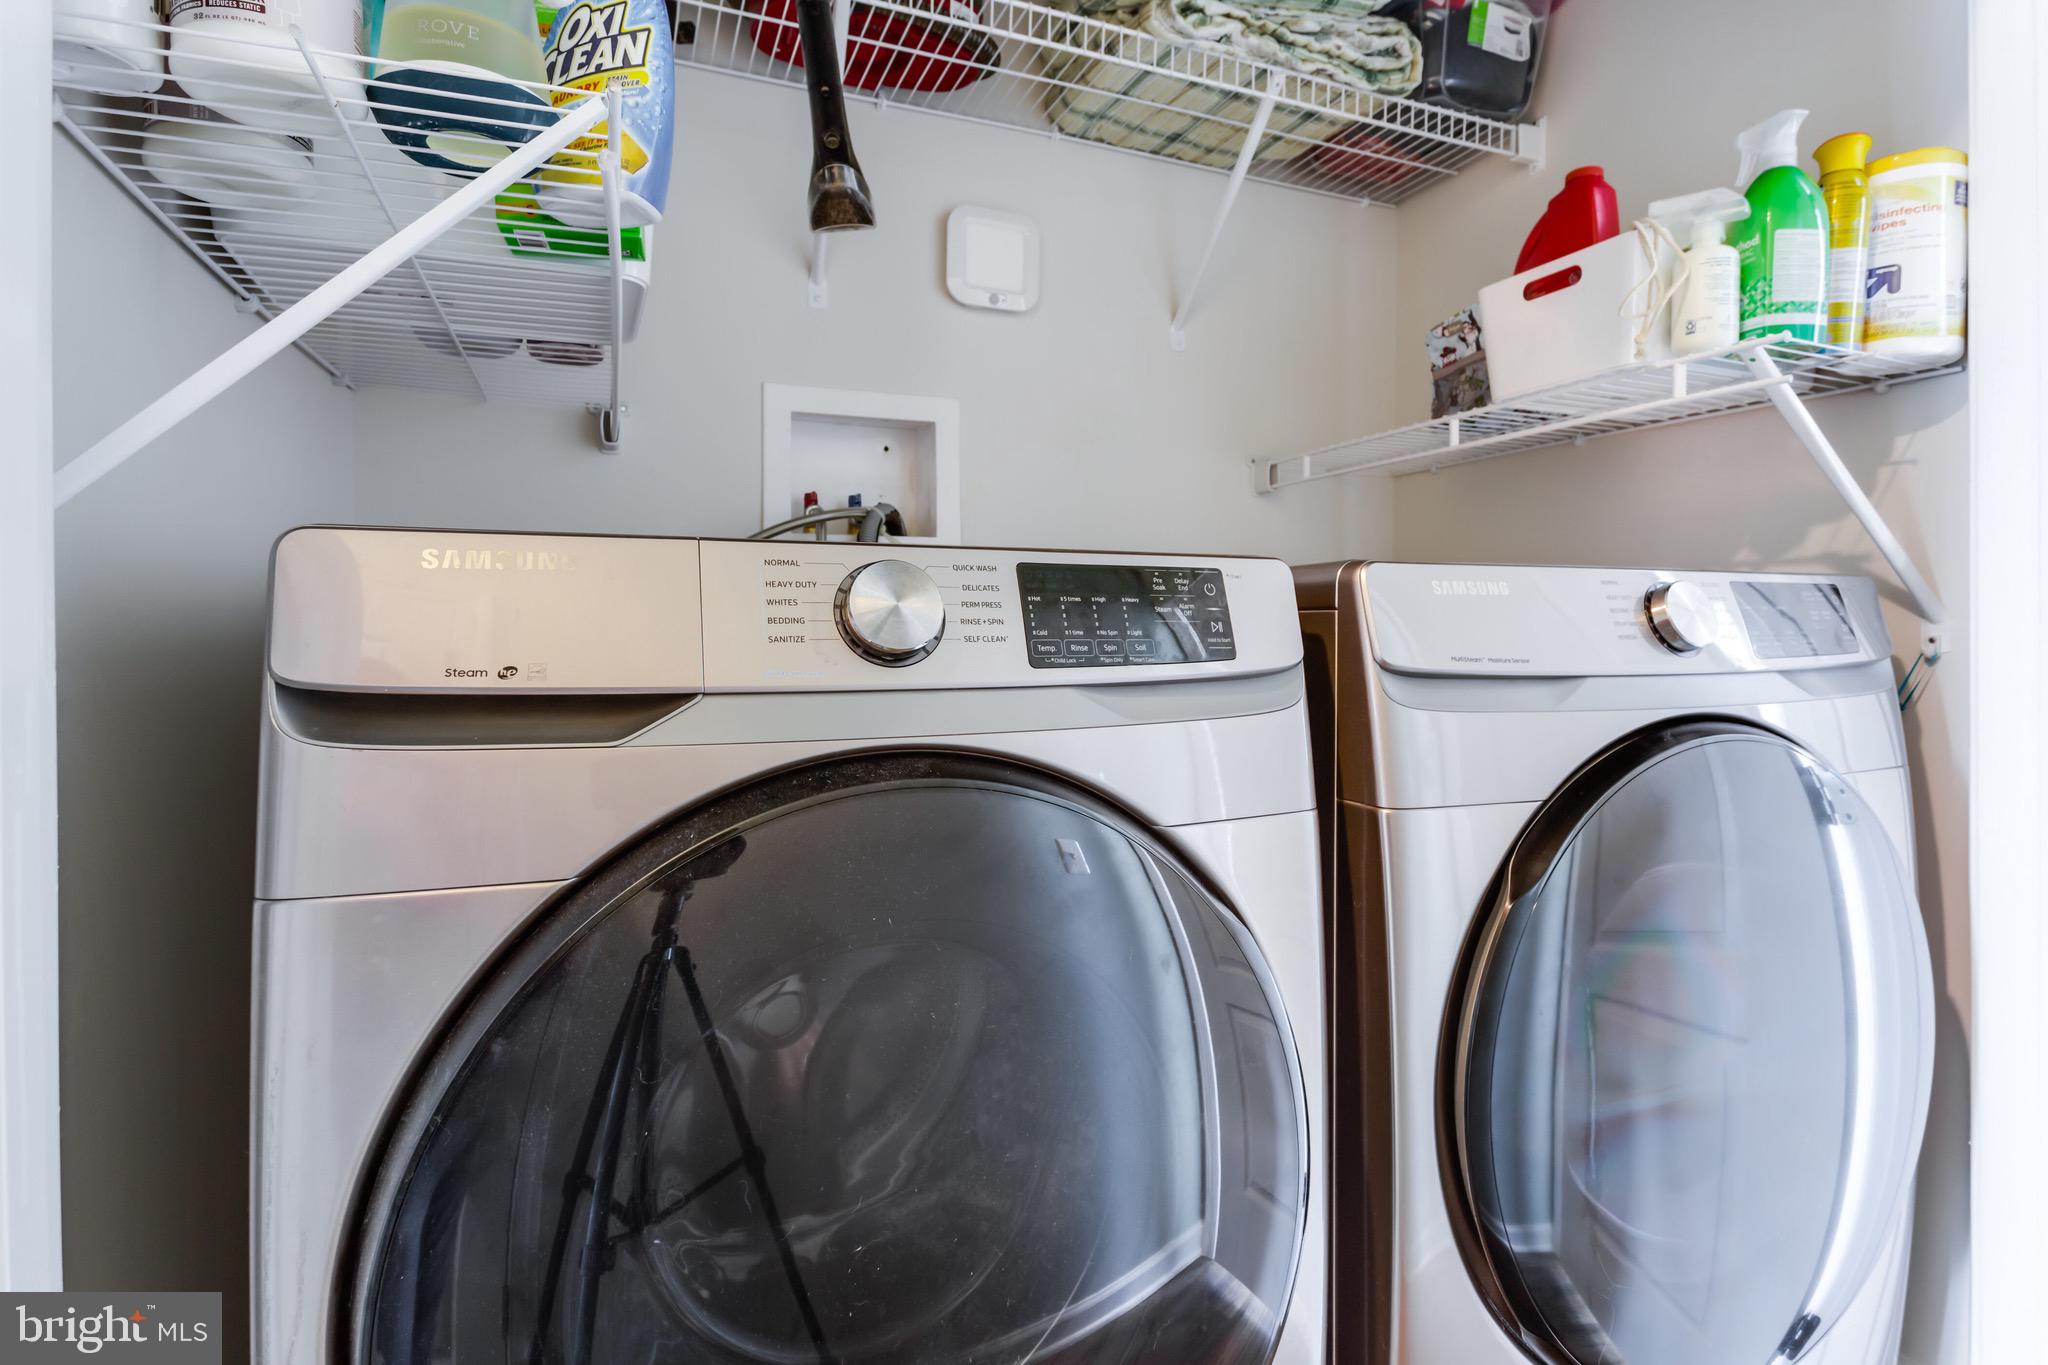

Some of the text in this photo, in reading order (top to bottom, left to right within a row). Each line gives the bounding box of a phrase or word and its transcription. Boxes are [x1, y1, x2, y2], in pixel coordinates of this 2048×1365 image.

[239, 2, 261, 12] STATIC
[193, 12, 204, 20] 32
[558, 2, 626, 53] OXI
[545, 29, 650, 87] CLEAN
[764, 559, 801, 567] NORMAL
[952, 564, 975, 572] QUICK
[765, 580, 818, 589] HEAVY DUTY
[961, 584, 1000, 592] DELICATES
[1431, 580, 1510, 596] SAMSUNG
[961, 601, 1002, 609] PERM PRESS
[767, 617, 806, 625] BEDDING
[960, 618, 982, 626] RINSE
[987, 618, 1004, 626] SPIN
[963, 635, 981, 643] SELF
[1037, 644, 1057, 653] Temp.
[1070, 644, 1089, 652] Rinse
[1103, 644, 1118, 653] Spin
[1134, 643, 1147, 651] Soil
[444, 667, 489, 678] Steam
